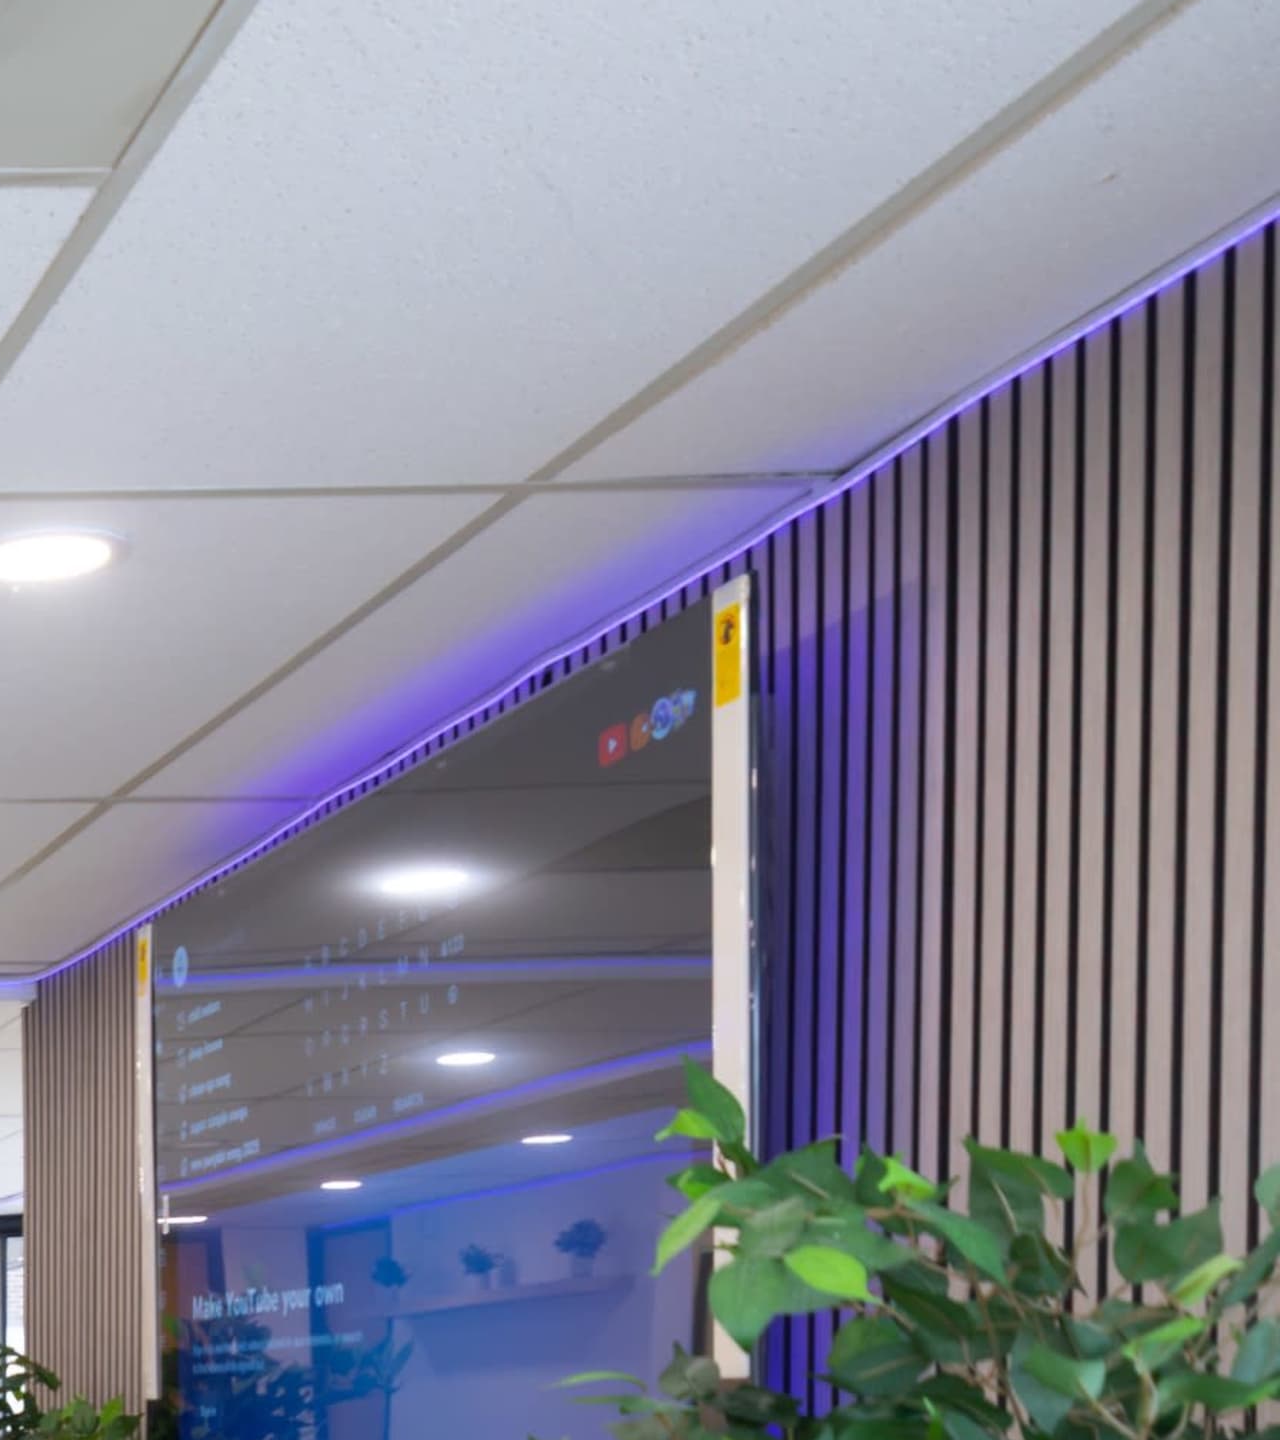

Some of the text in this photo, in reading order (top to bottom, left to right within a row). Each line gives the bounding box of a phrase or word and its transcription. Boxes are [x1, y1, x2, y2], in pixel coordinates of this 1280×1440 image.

[192, 1282, 345, 1320] Make YouTube your own
